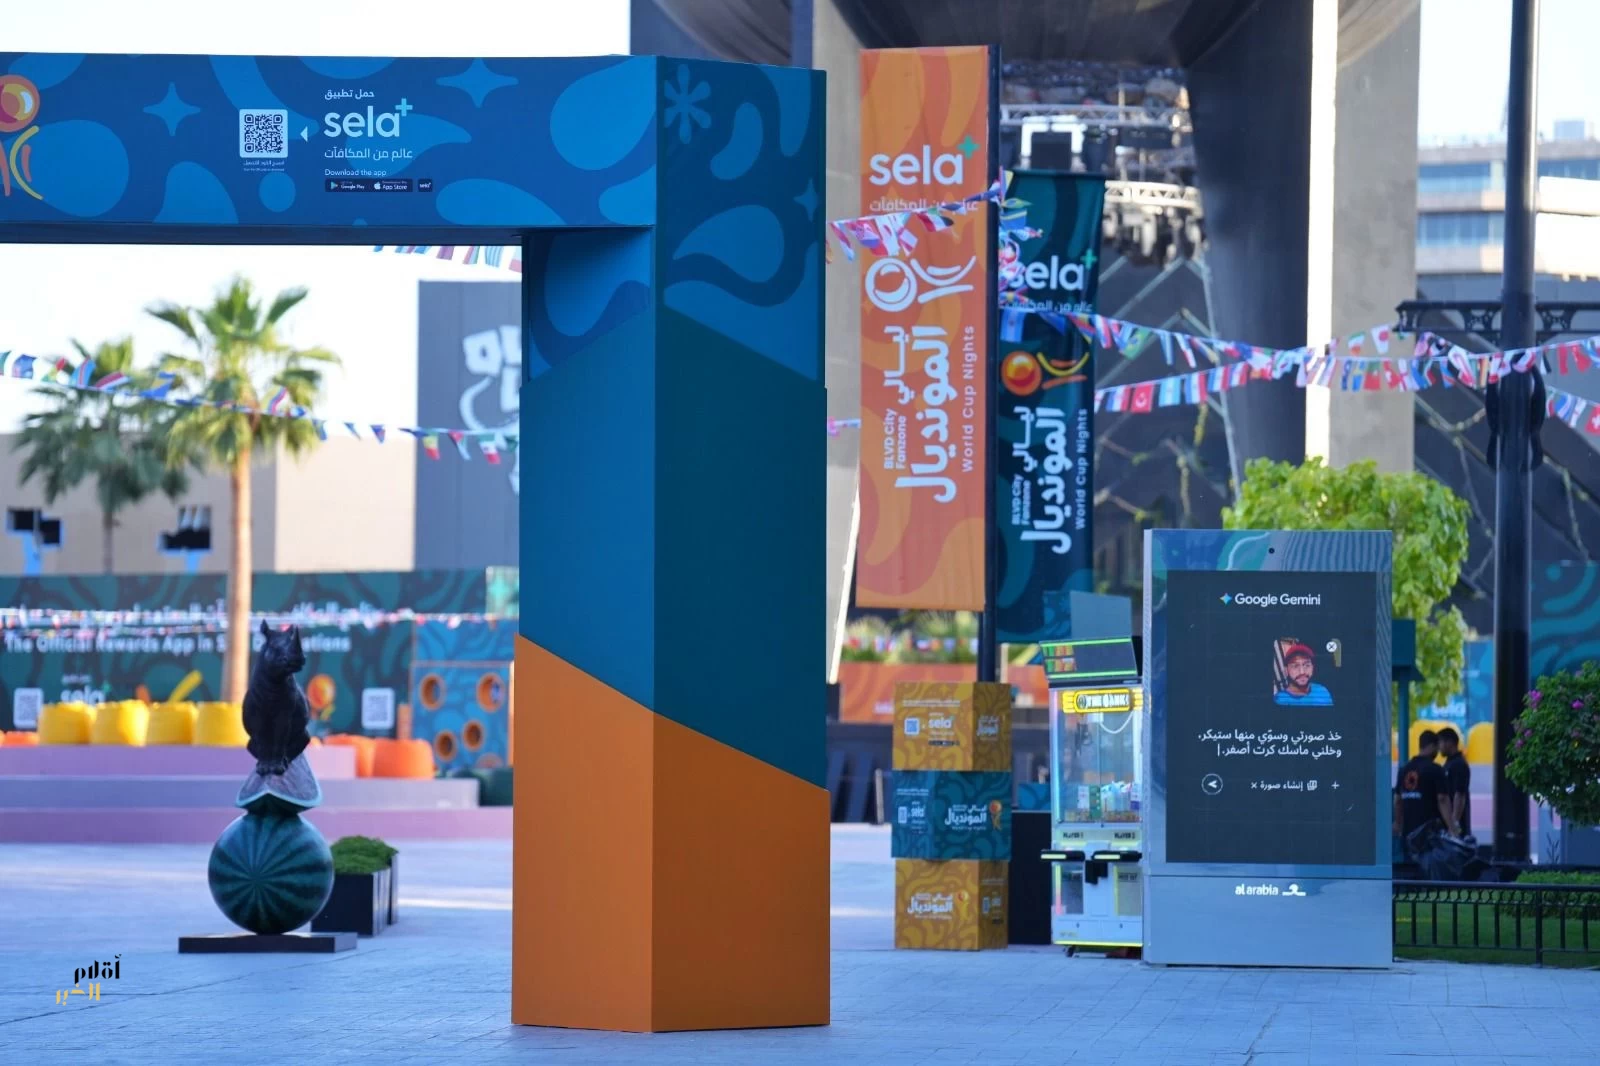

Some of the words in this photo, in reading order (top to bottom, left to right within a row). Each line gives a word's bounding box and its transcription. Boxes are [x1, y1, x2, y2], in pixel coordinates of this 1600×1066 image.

[324, 88, 353, 101] تطبيق
[355, 88, 375, 100] حمل
[324, 146, 371, 159] المكافآت
[373, 148, 389, 161] من
[391, 148, 413, 162] عالم
[324, 168, 359, 176] Download
[360, 168, 373, 176] the
[373, 170, 387, 178] app
[962, 325, 978, 379] Nights
[962, 385, 977, 418] Cup
[883, 407, 897, 436] City
[895, 325, 958, 503] المونديال
[1076, 408, 1090, 453] Nights
[895, 415, 907, 470] Fanzone
[962, 424, 975, 472] World
[883, 437, 895, 470] BLVD
[1075, 456, 1089, 486] Cup
[1020, 407, 1073, 554] المونديال
[1075, 489, 1086, 530] World
[1234, 592, 1278, 608] Google
[1279, 593, 1321, 605] Gemini
[1234, 728, 1255, 742] منها
[1290, 730, 1325, 746] صورتي
[1328, 730, 1342, 741] خذ
[1252, 744, 1276, 757] كرت
[1277, 744, 1309, 755] ماسك
[1311, 744, 1342, 760] وخلني
[1260, 780, 1281, 791] صورة
[1282, 780, 1304, 792] إنشاء
[1235, 883, 1245, 896] al
[1246, 884, 1279, 896] arabia
